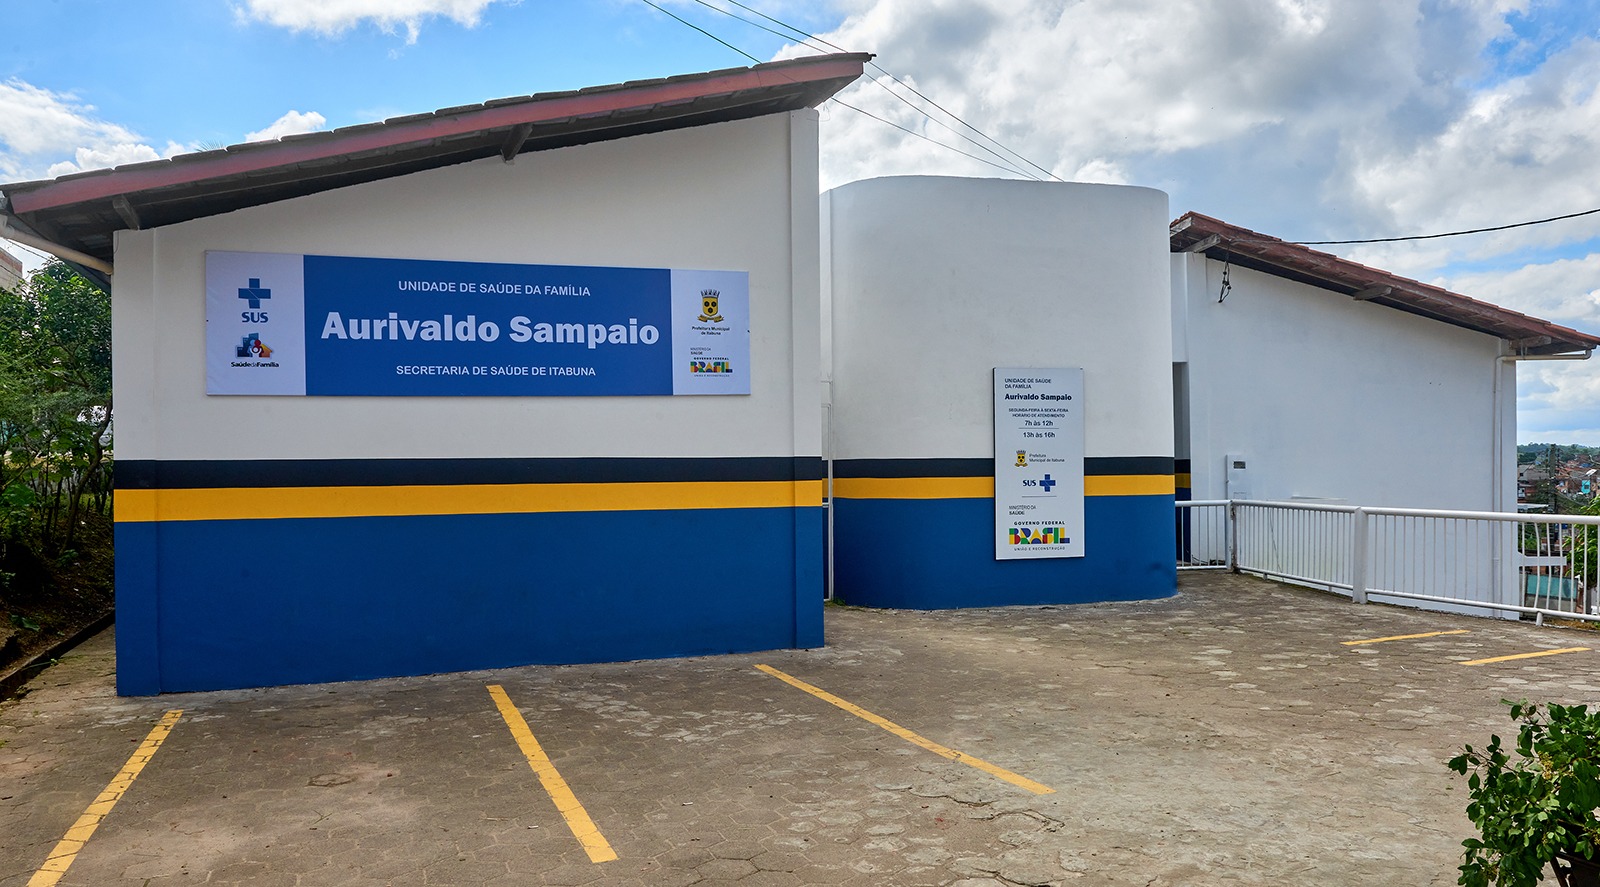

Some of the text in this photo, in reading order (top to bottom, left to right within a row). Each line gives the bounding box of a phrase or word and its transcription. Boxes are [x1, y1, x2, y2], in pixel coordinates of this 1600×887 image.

[399, 281, 591, 296] UNIDADE DE SAÚDE DA FAMÍLIA
[242, 312, 268, 323] SUS
[321, 312, 659, 349] Aurivaldo Sampaio
[396, 364, 596, 376] SECRETARIA DE SAÚDE DE ITABUNA
[690, 361, 733, 373] BRASIL
[1040, 394, 1072, 402] Sampaio
[1009, 527, 1070, 544] BRASIL
